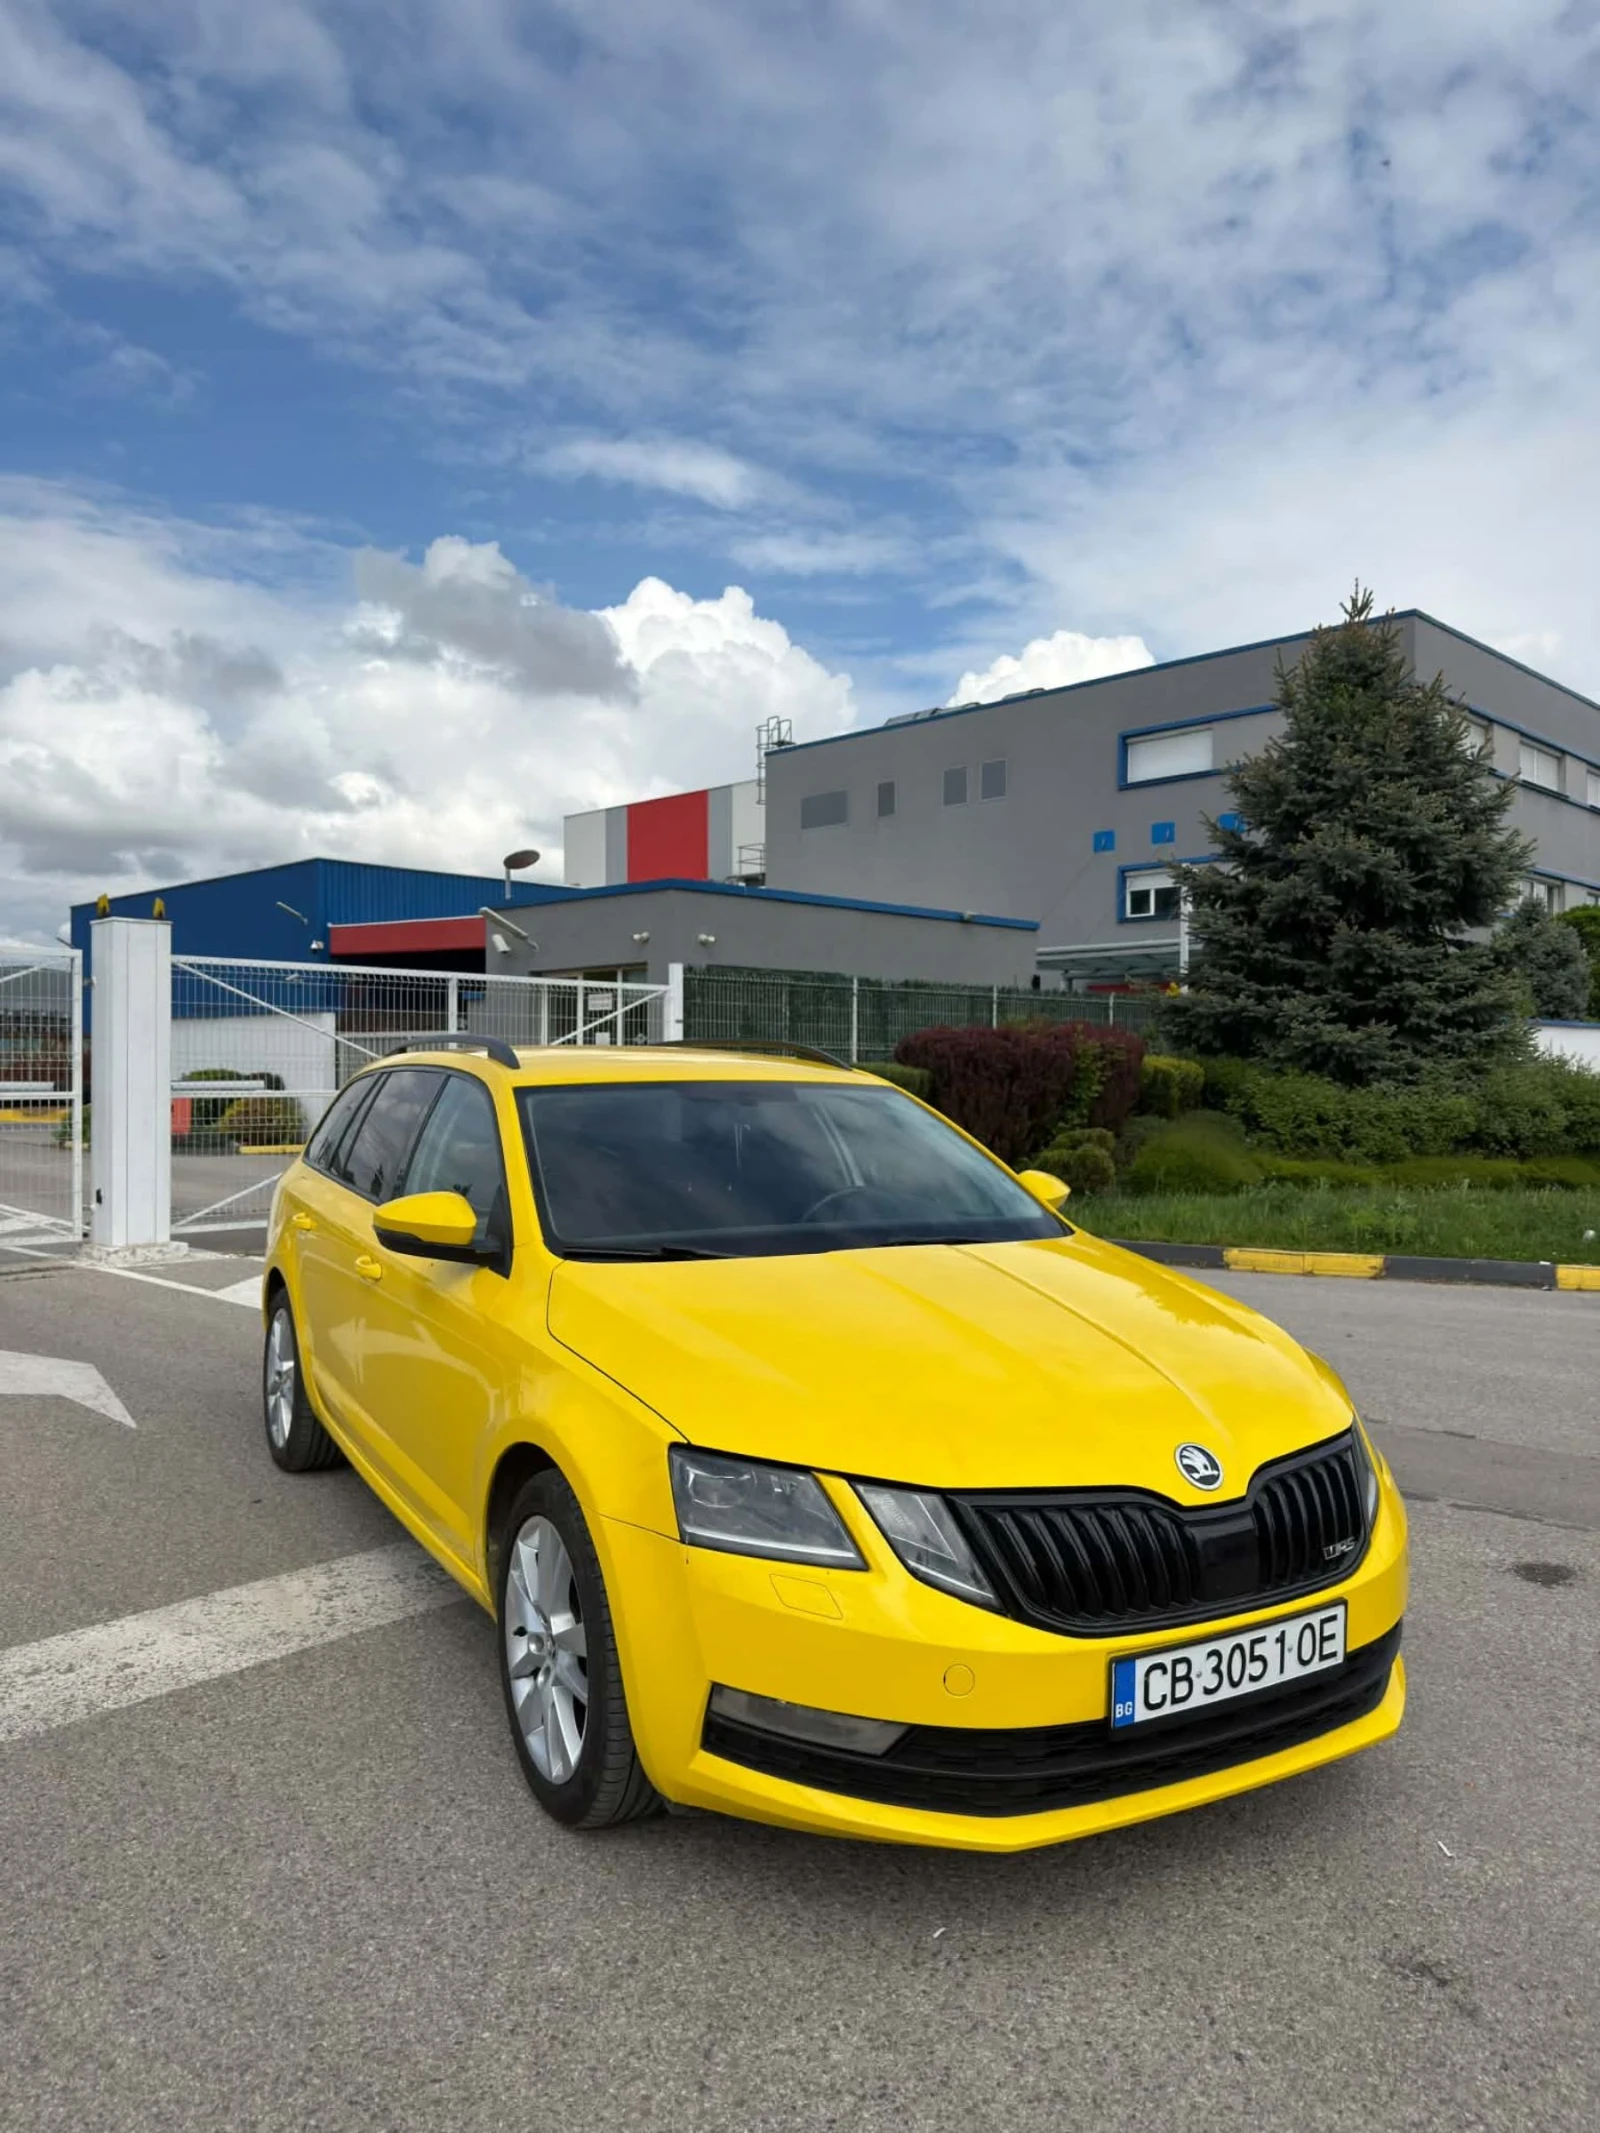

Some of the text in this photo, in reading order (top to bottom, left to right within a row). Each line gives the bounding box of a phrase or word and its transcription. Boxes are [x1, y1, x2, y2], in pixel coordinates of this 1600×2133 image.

[1143, 1614, 1339, 1711] CB 3051 OE
[1115, 1701, 1133, 1718] BG
